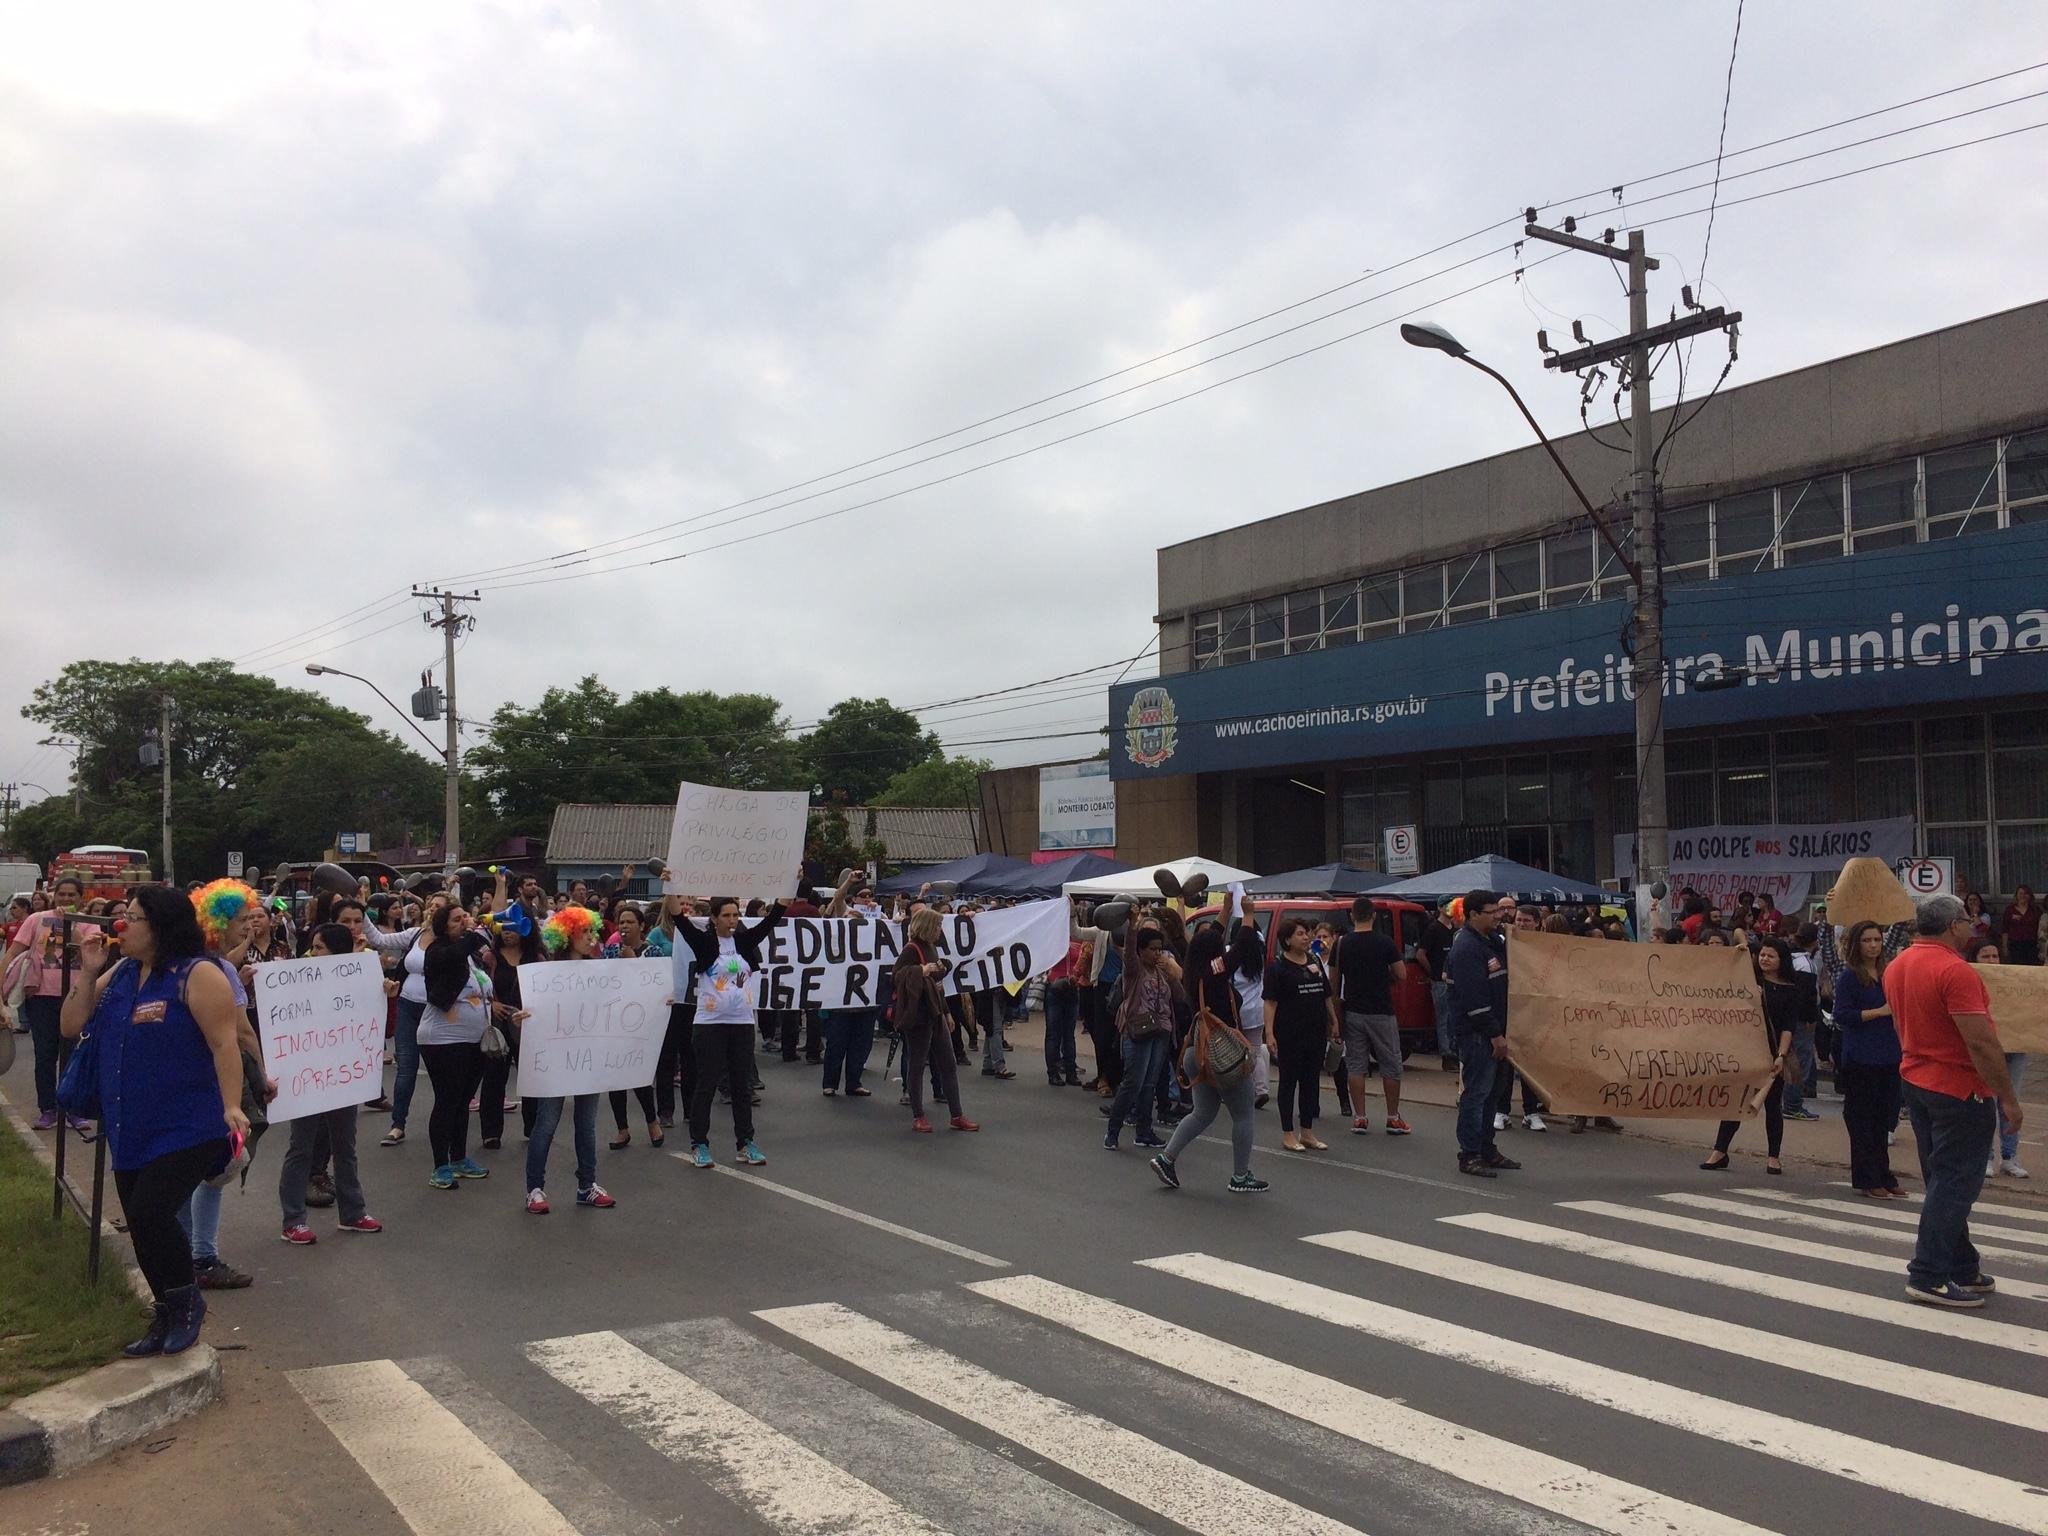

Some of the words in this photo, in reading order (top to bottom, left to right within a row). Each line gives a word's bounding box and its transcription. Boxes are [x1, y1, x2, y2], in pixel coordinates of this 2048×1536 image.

[1215, 694, 1427, 738] www.cachoeirinha.rs.gov.br
[776, 796, 801, 812] DE
[1057, 803, 1089, 815] MONTEIRO
[1090, 801, 1115, 812] LOBATO
[1396, 835, 1405, 850] E
[1673, 839, 1693, 861] AO
[1698, 836, 1750, 860] GOLPE
[1789, 830, 1872, 857] SALÁRIOS
[1730, 873, 1791, 896] PAGUEM
[1918, 867, 1934, 887] E
[266, 966, 323, 989] CONTRA
[331, 961, 362, 978] TODA
[532, 971, 623, 993] ESTAMOS
[640, 971, 665, 986] DE
[843, 942, 1031, 1006] REPEITO
[270, 999, 313, 1026] FORMA
[333, 994, 355, 1011] DE
[556, 996, 646, 1035] LUTO
[534, 1050, 549, 1072] E
[566, 1048, 592, 1072] NA
[604, 1050, 644, 1069] LUTA
[1614, 1049, 1740, 1079] VEREADORES
[1599, 1082, 1632, 1109] R$
